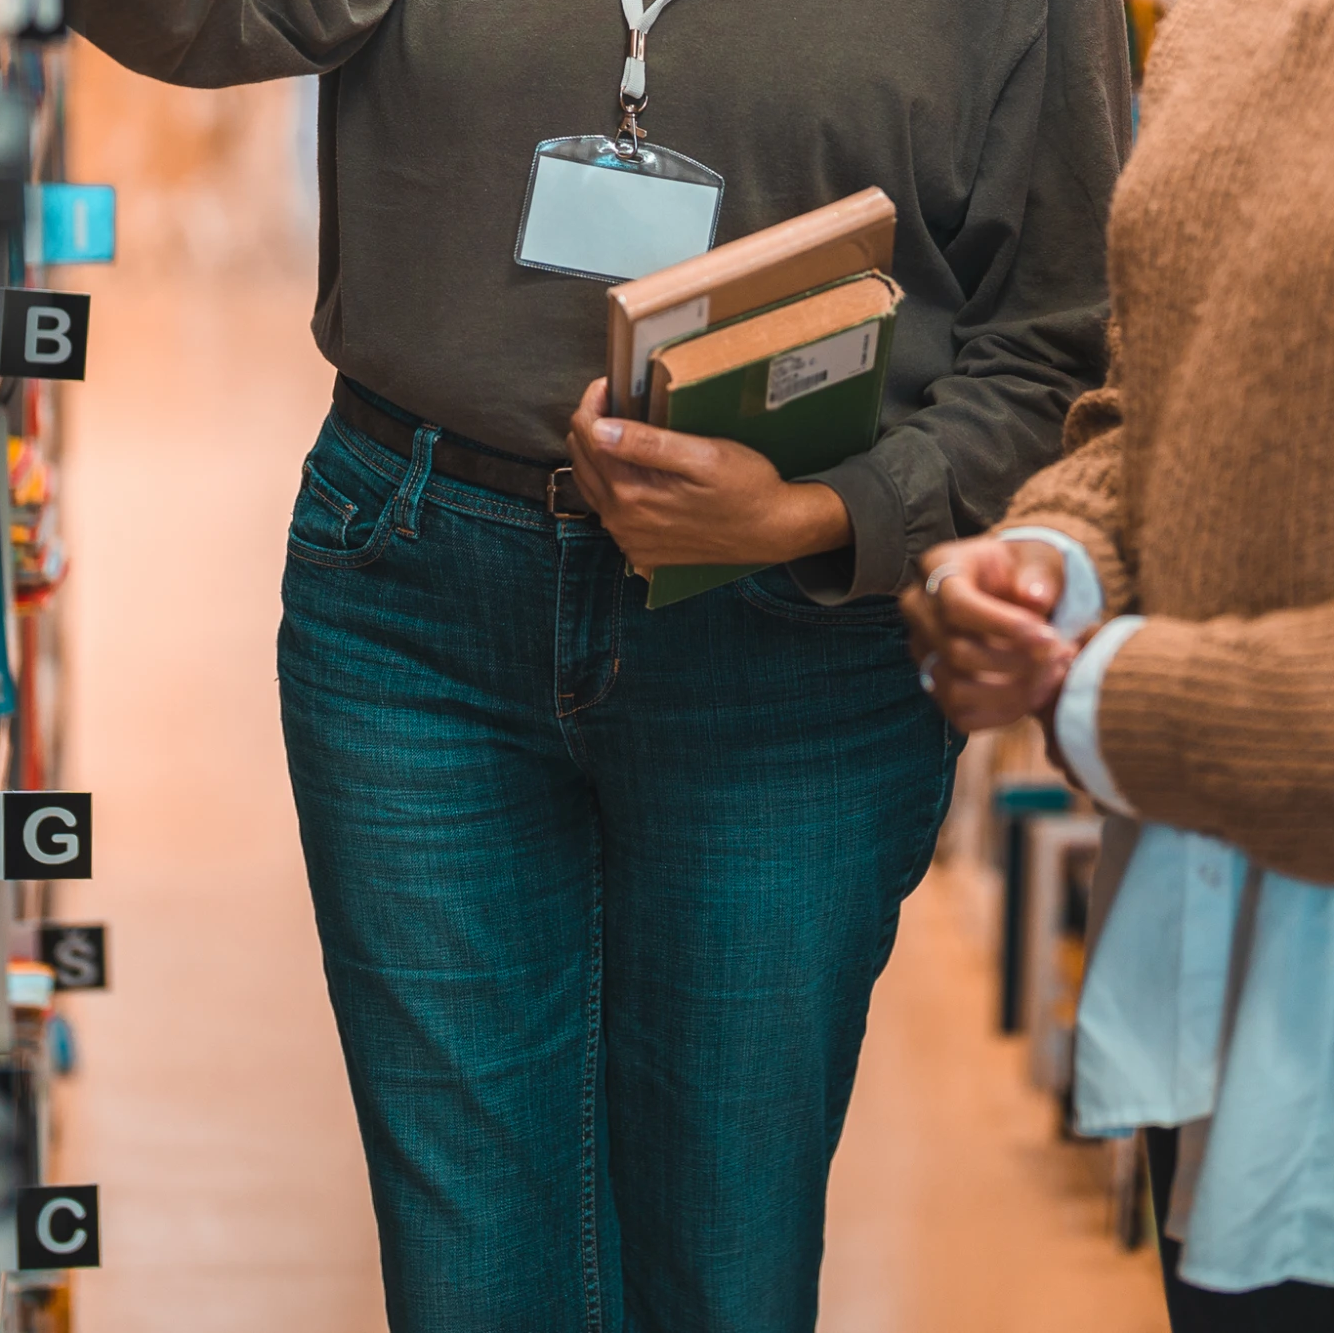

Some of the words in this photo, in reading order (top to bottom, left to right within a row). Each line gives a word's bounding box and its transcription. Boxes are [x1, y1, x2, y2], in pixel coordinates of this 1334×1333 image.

[74, 199, 88, 251] I
[24, 306, 72, 365] B
[23, 806, 79, 866] G
[36, 1197, 87, 1255] C
